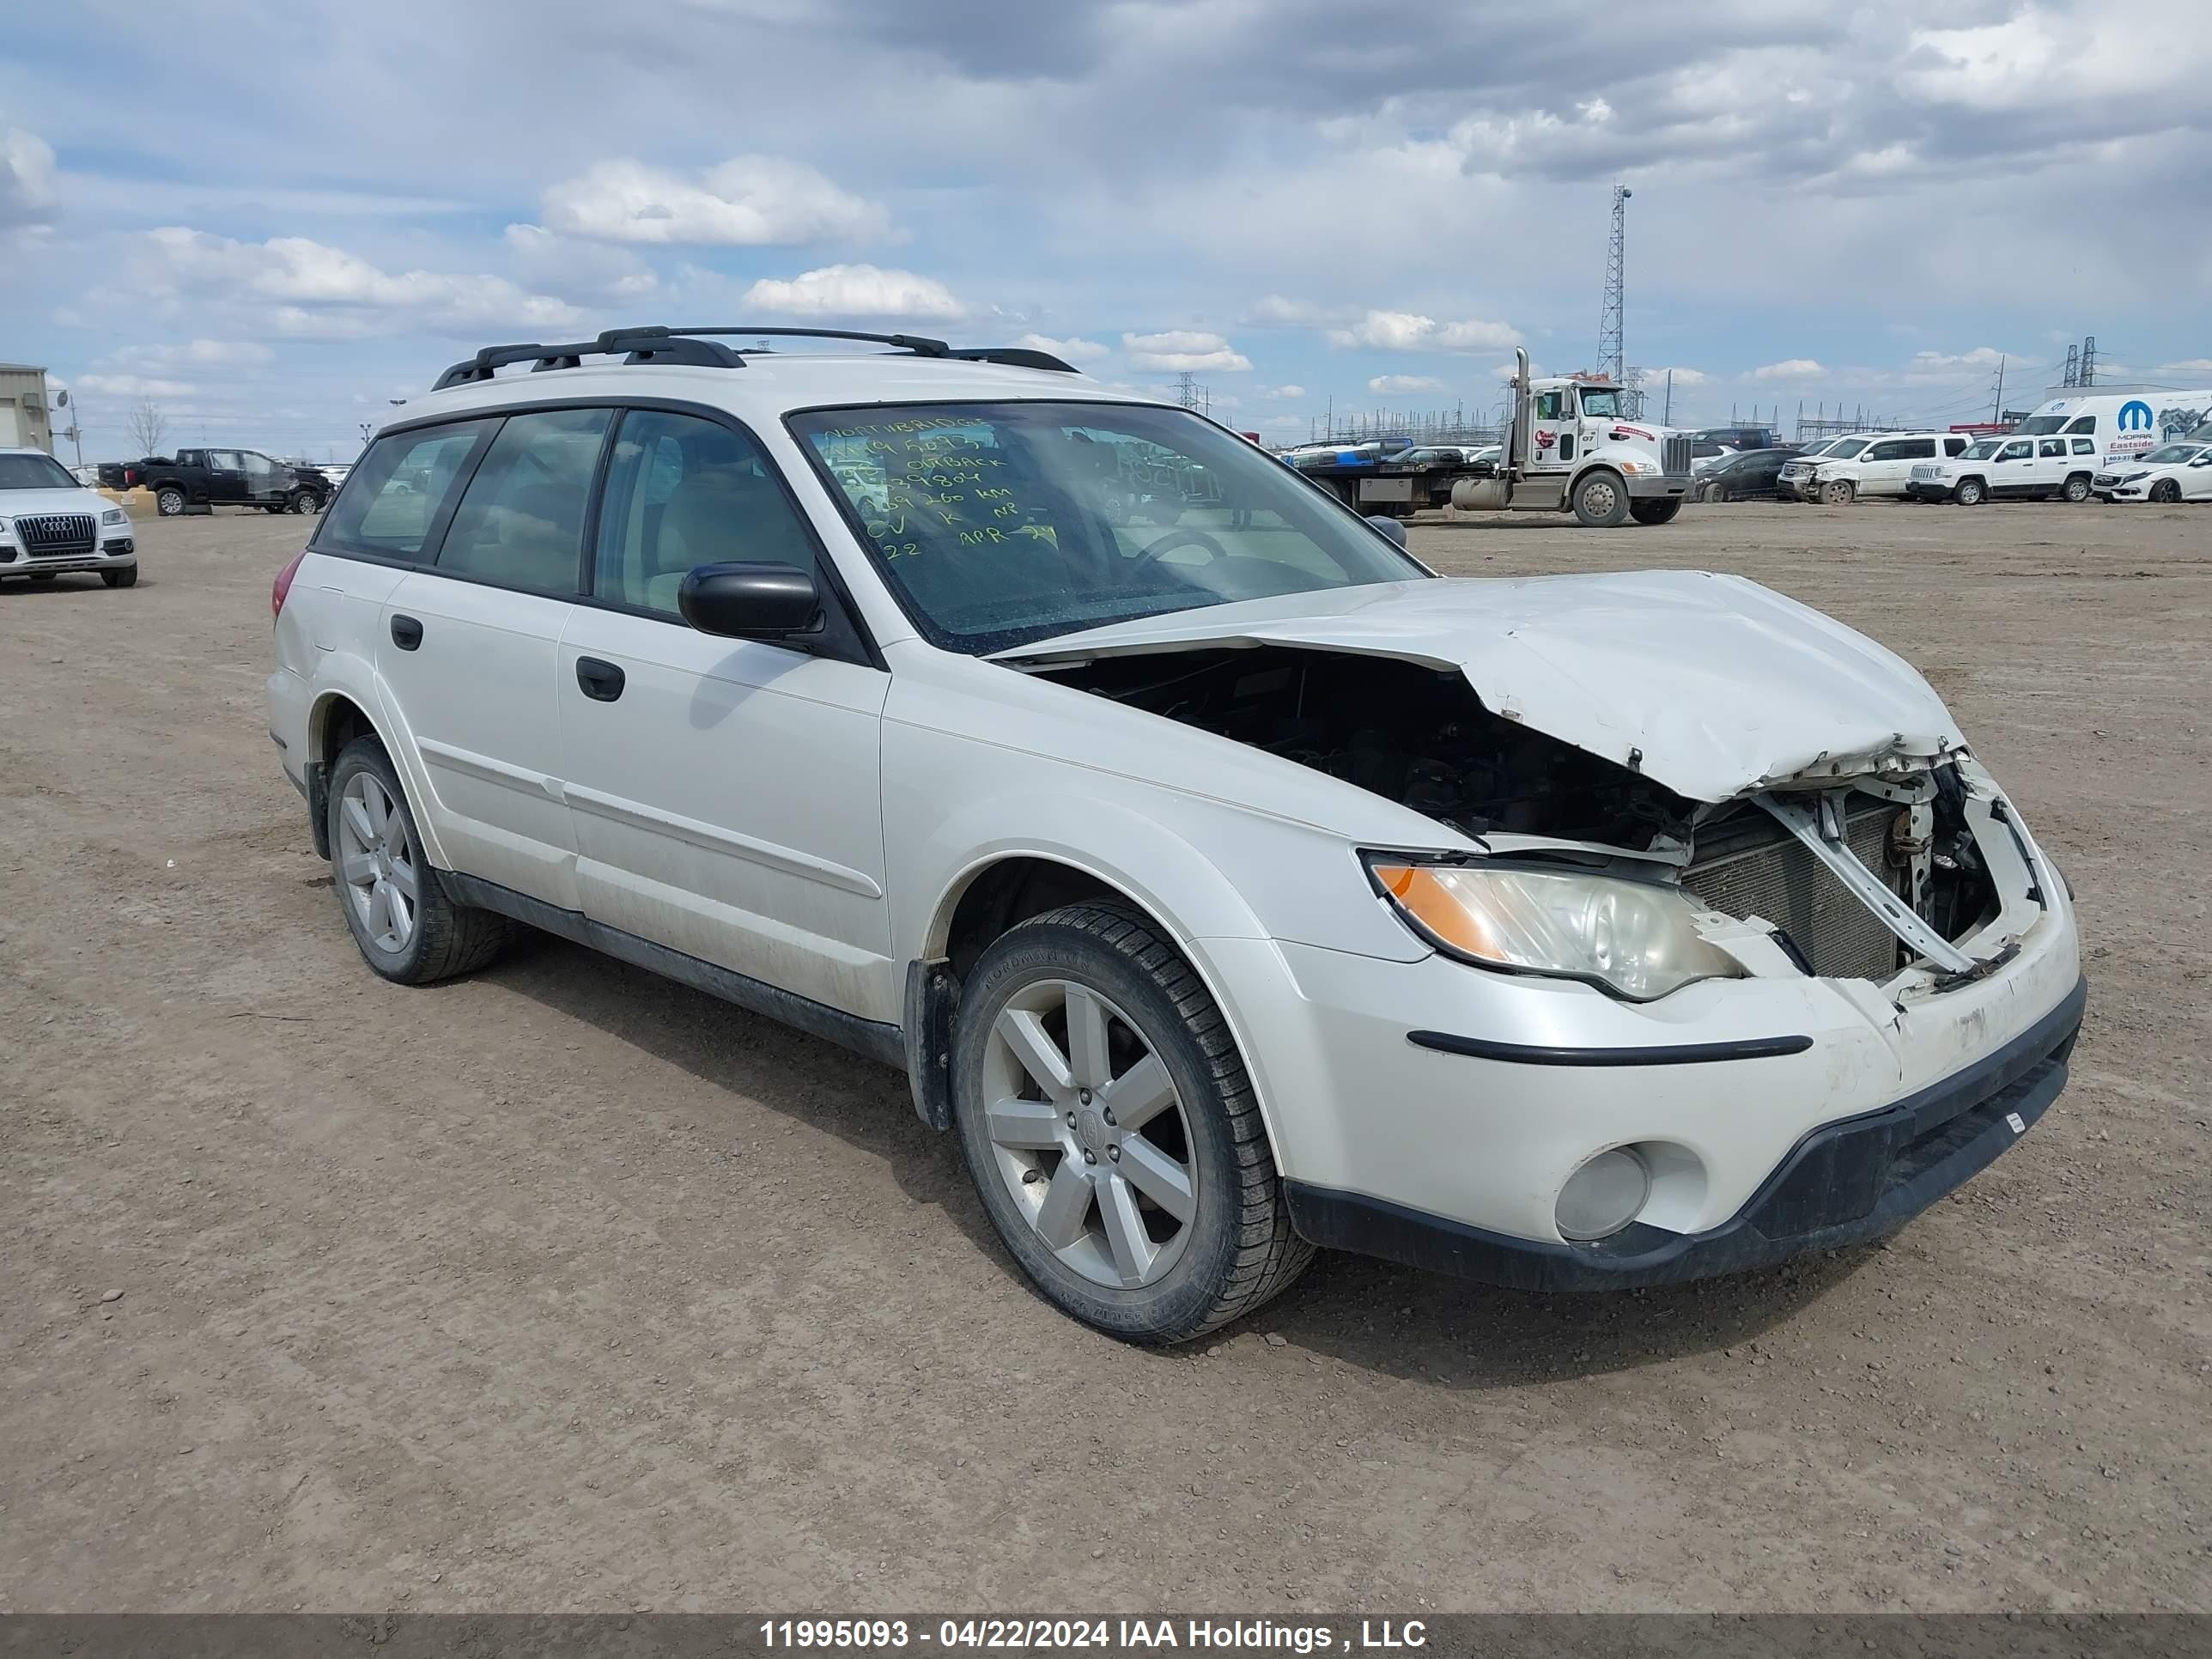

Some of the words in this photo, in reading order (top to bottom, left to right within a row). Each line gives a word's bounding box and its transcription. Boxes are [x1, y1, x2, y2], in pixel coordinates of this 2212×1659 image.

[2110, 441, 2154, 449] Eastside
[907, 456, 1007, 471] OUTBACK
[884, 543, 922, 561] 22
[959, 526, 1011, 546] APR
